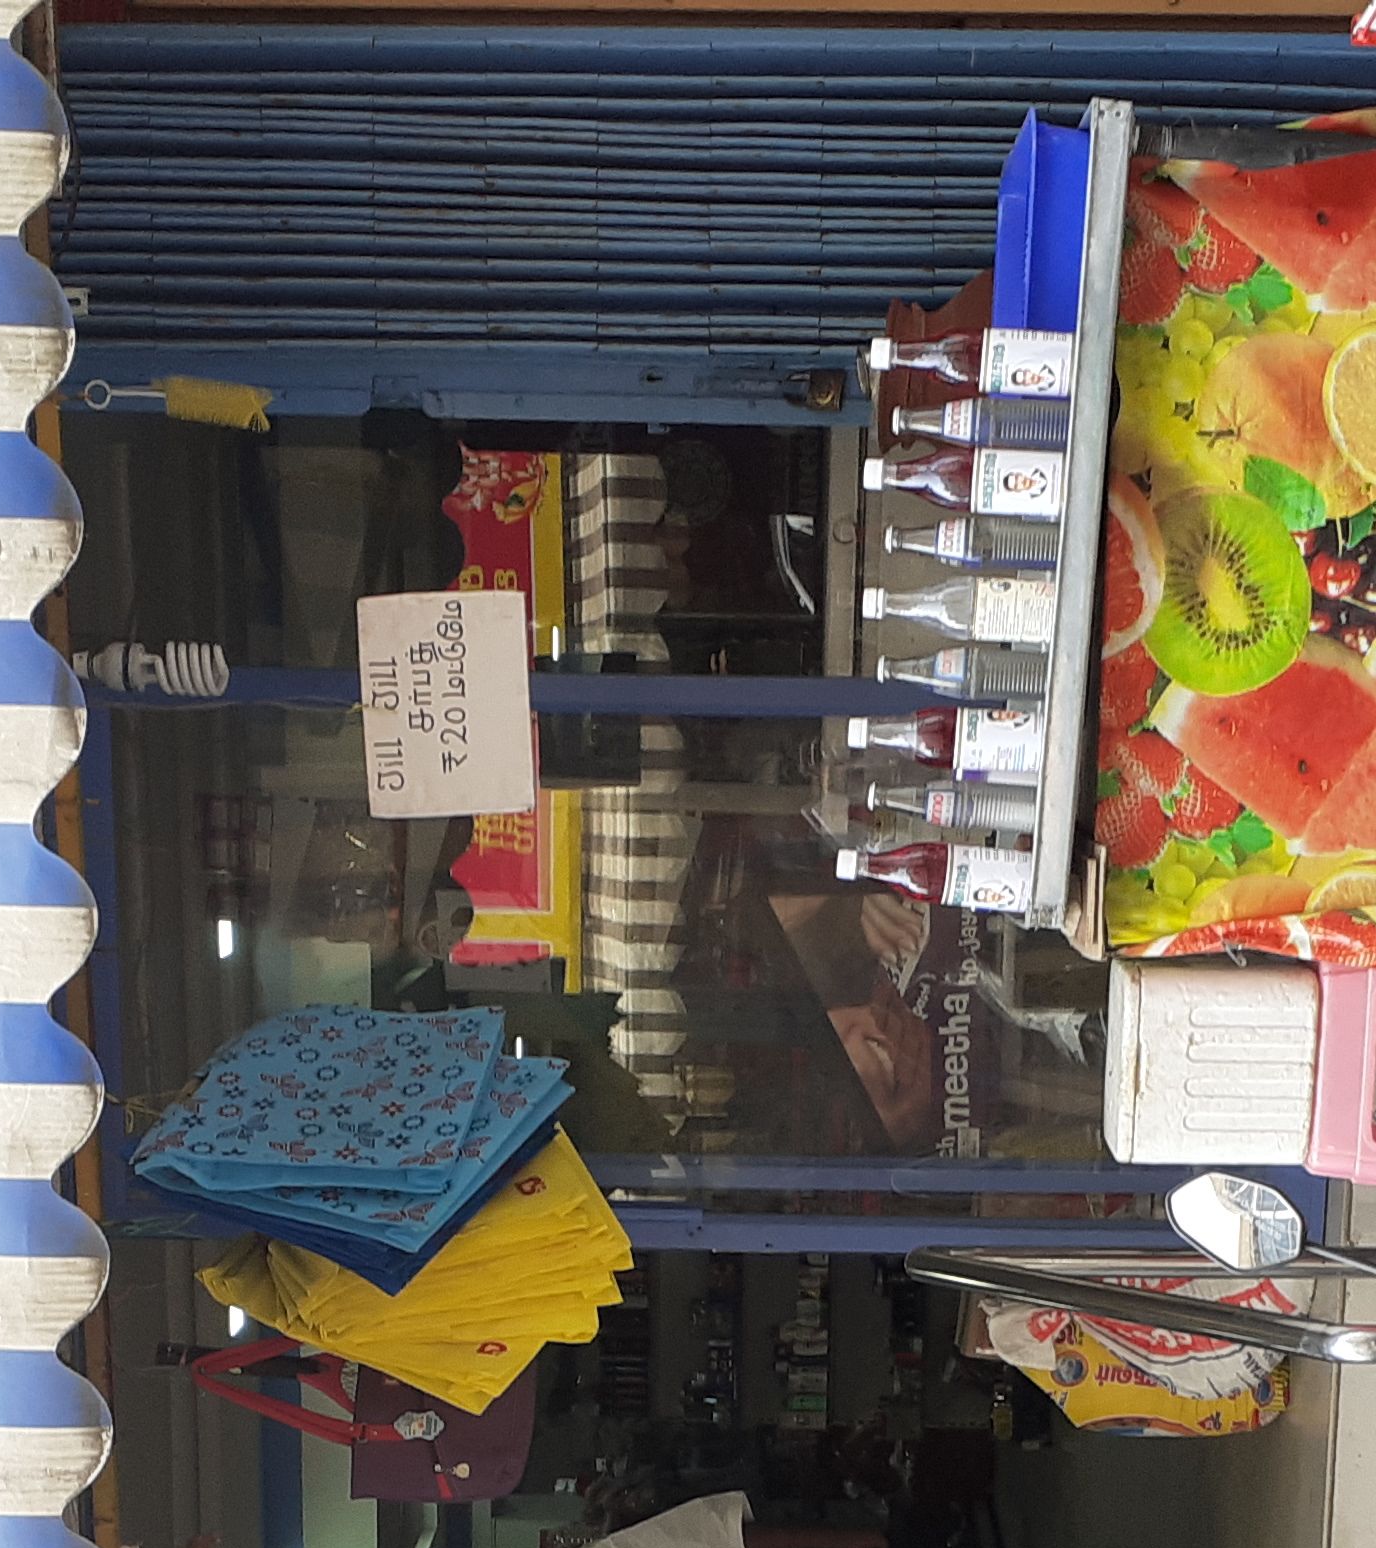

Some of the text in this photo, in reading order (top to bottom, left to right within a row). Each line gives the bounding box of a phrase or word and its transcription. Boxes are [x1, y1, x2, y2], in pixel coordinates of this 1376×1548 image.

[405, 641, 439, 733] சர்பத்
[436, 599, 467, 698] மட்டுமே
[938, 993, 972, 1129] meetha
